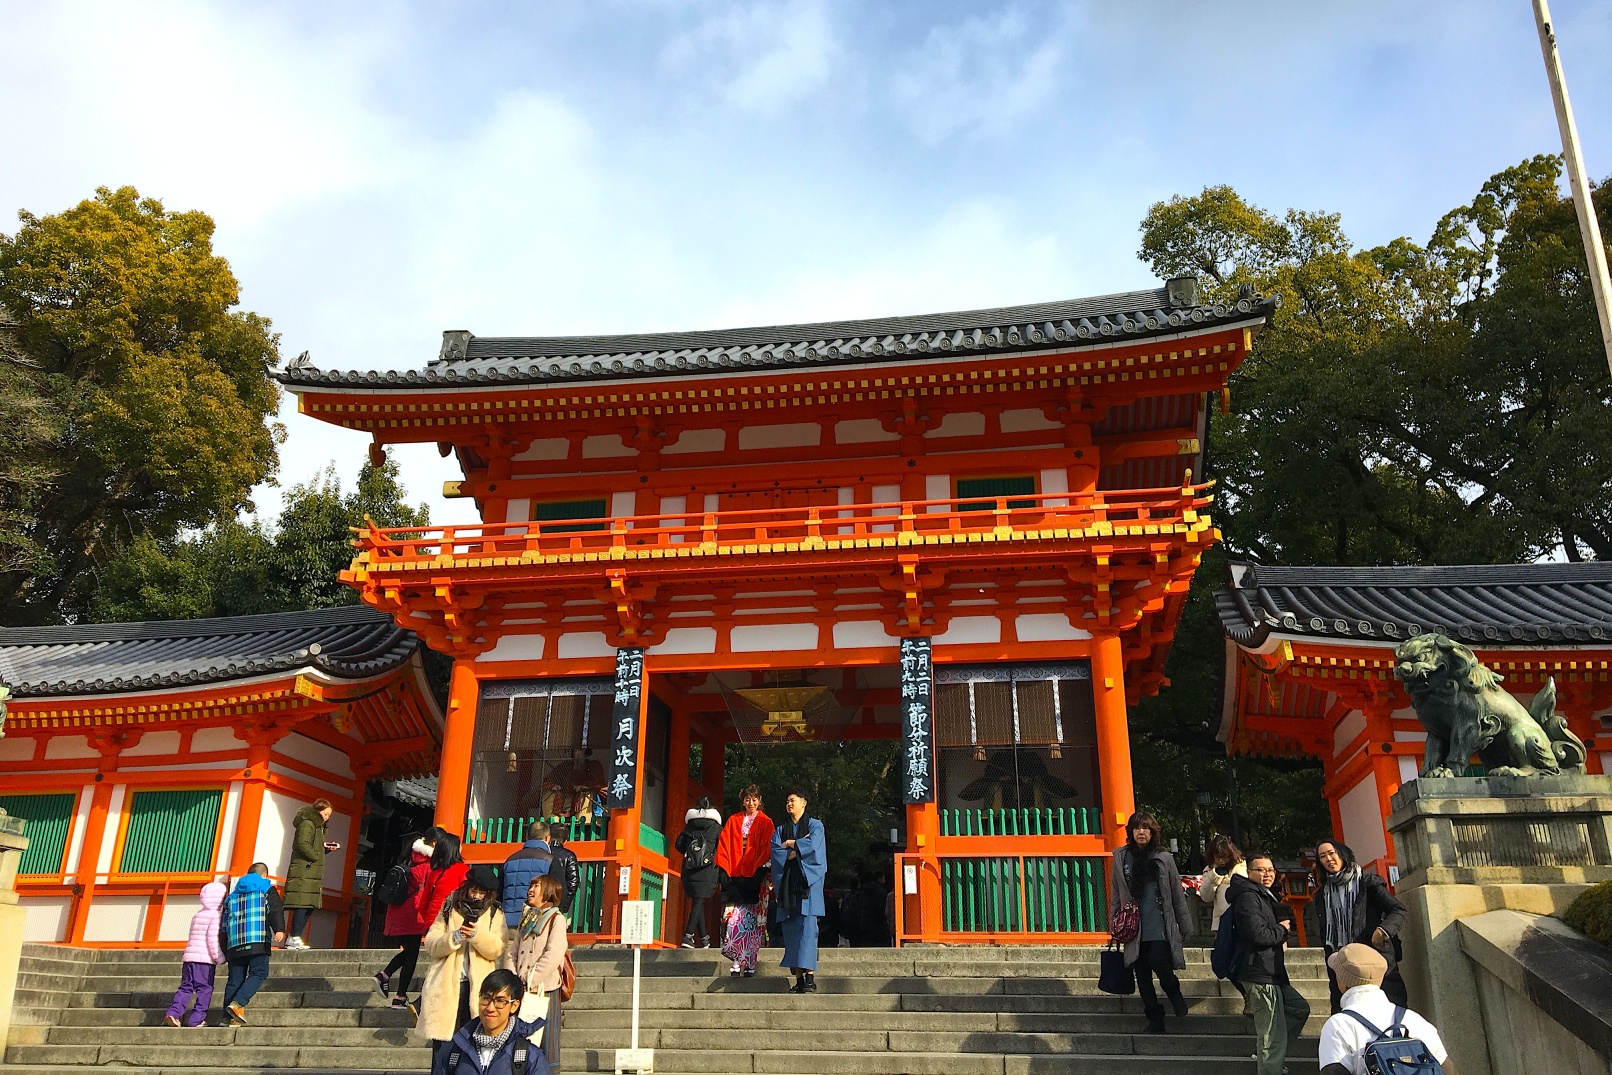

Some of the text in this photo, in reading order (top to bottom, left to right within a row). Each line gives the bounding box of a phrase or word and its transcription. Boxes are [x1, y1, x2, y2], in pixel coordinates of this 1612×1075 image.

[615, 649, 629, 707] 午前十時
[629, 650, 643, 697] 二月一日
[900, 639, 917, 699] 午前九時
[916, 641, 931, 696] 二月二日
[611, 717, 635, 800] 月次祭
[906, 702, 928, 800] 節分祈願祭
